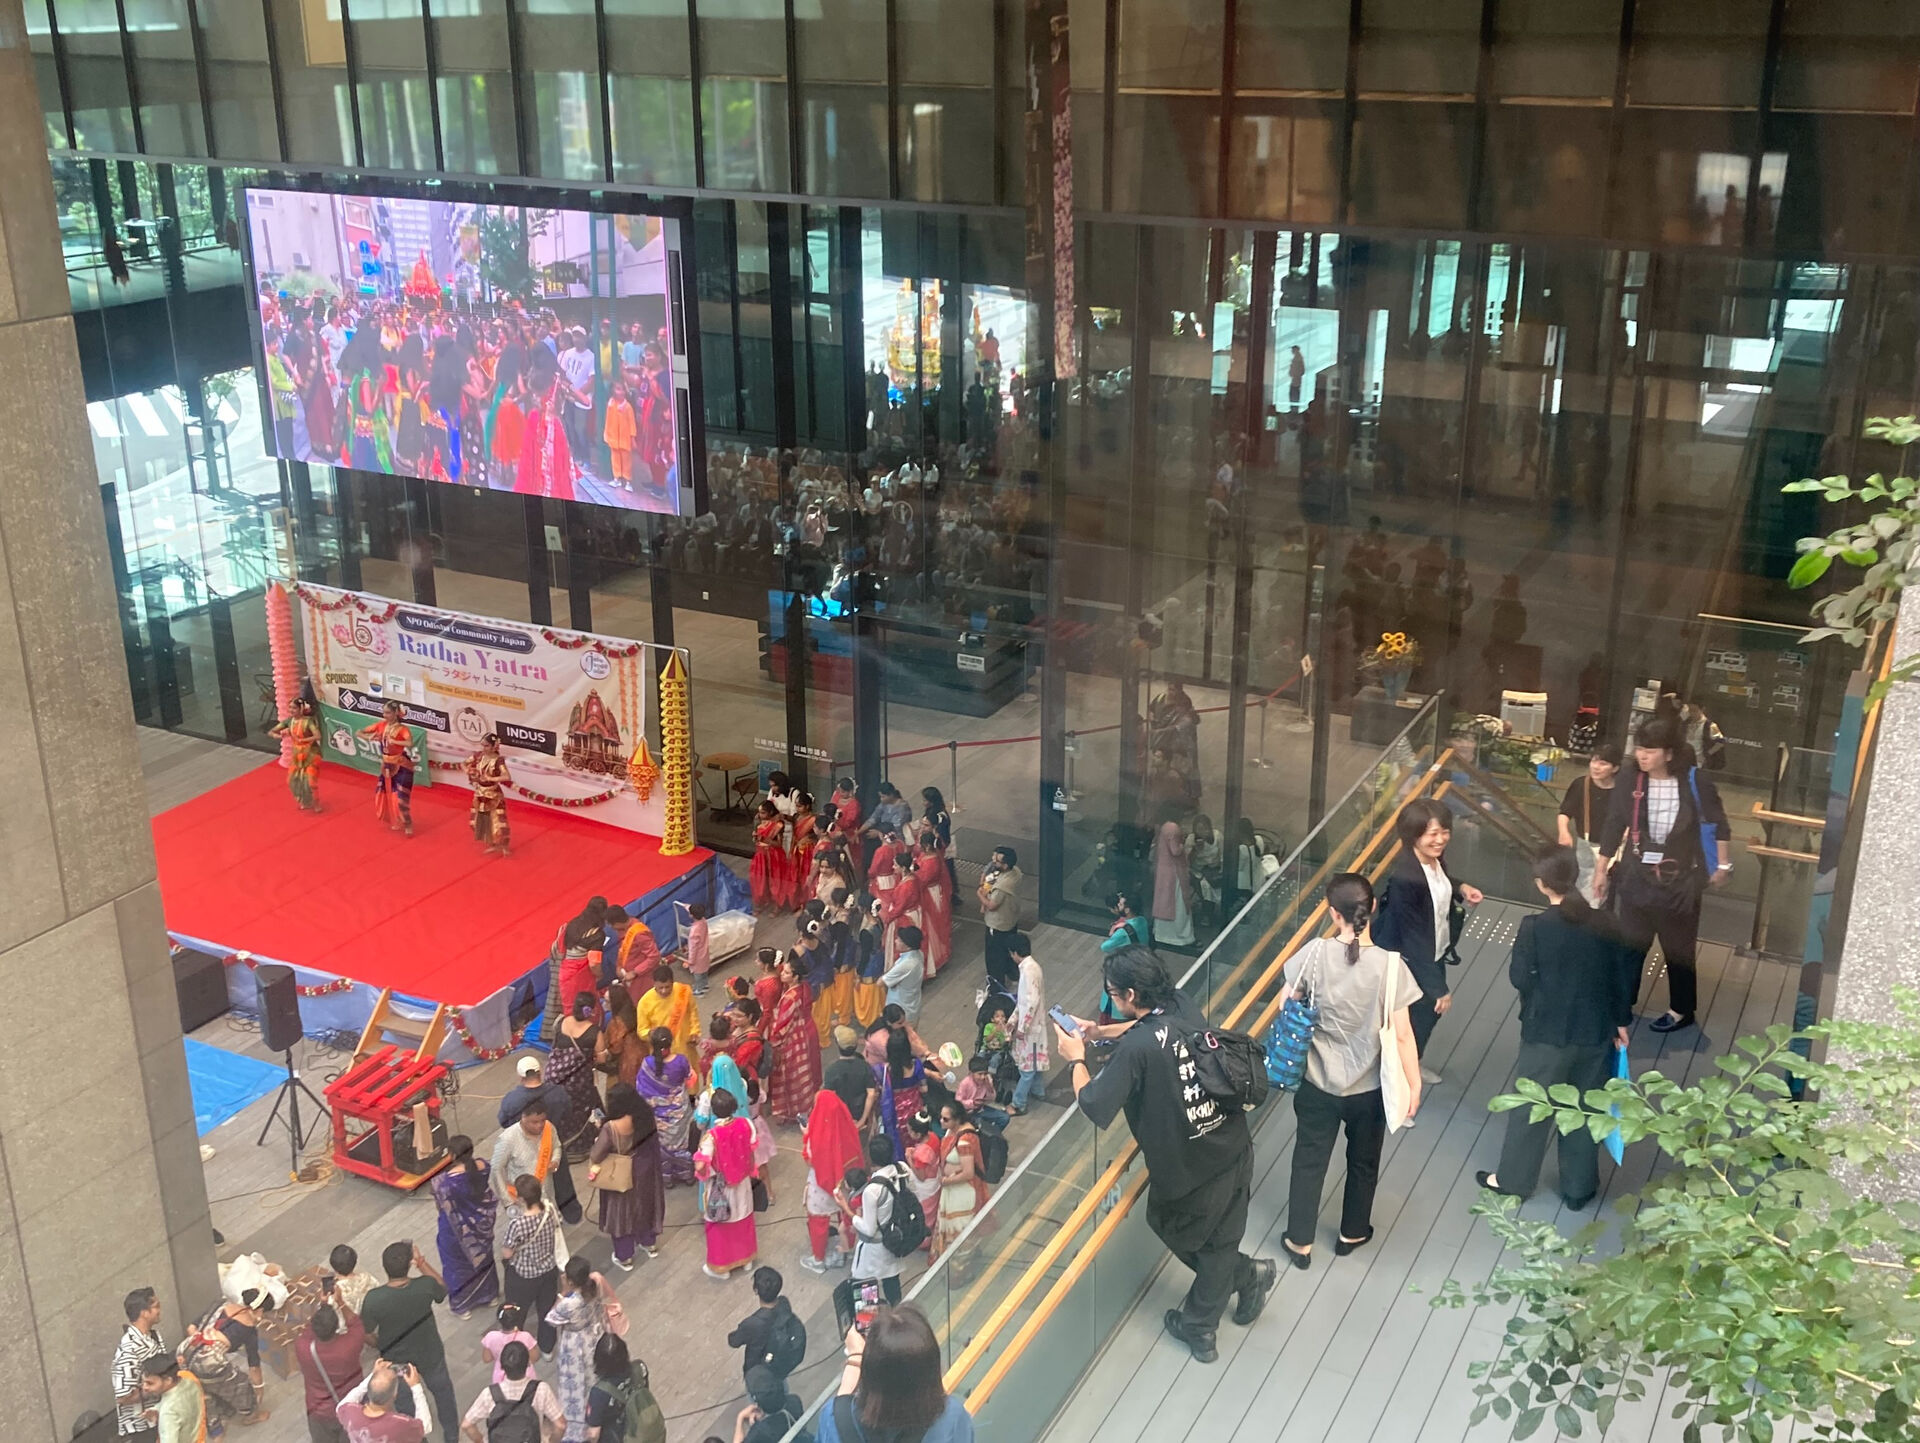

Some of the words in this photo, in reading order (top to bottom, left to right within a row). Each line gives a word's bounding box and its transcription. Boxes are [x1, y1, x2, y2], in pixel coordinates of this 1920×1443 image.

[405, 615, 423, 627] NPO
[423, 620, 450, 632] Odisha
[451, 625, 498, 643] Community
[499, 635, 526, 647] Japan
[397, 632, 468, 667] Ratha
[474, 648, 549, 681] Yatra
[325, 672, 358, 686] SPONSORS
[441, 666, 502, 687] ラタジャトラ
[460, 718, 482, 734] TAJ
[506, 726, 546, 743] INDUS
